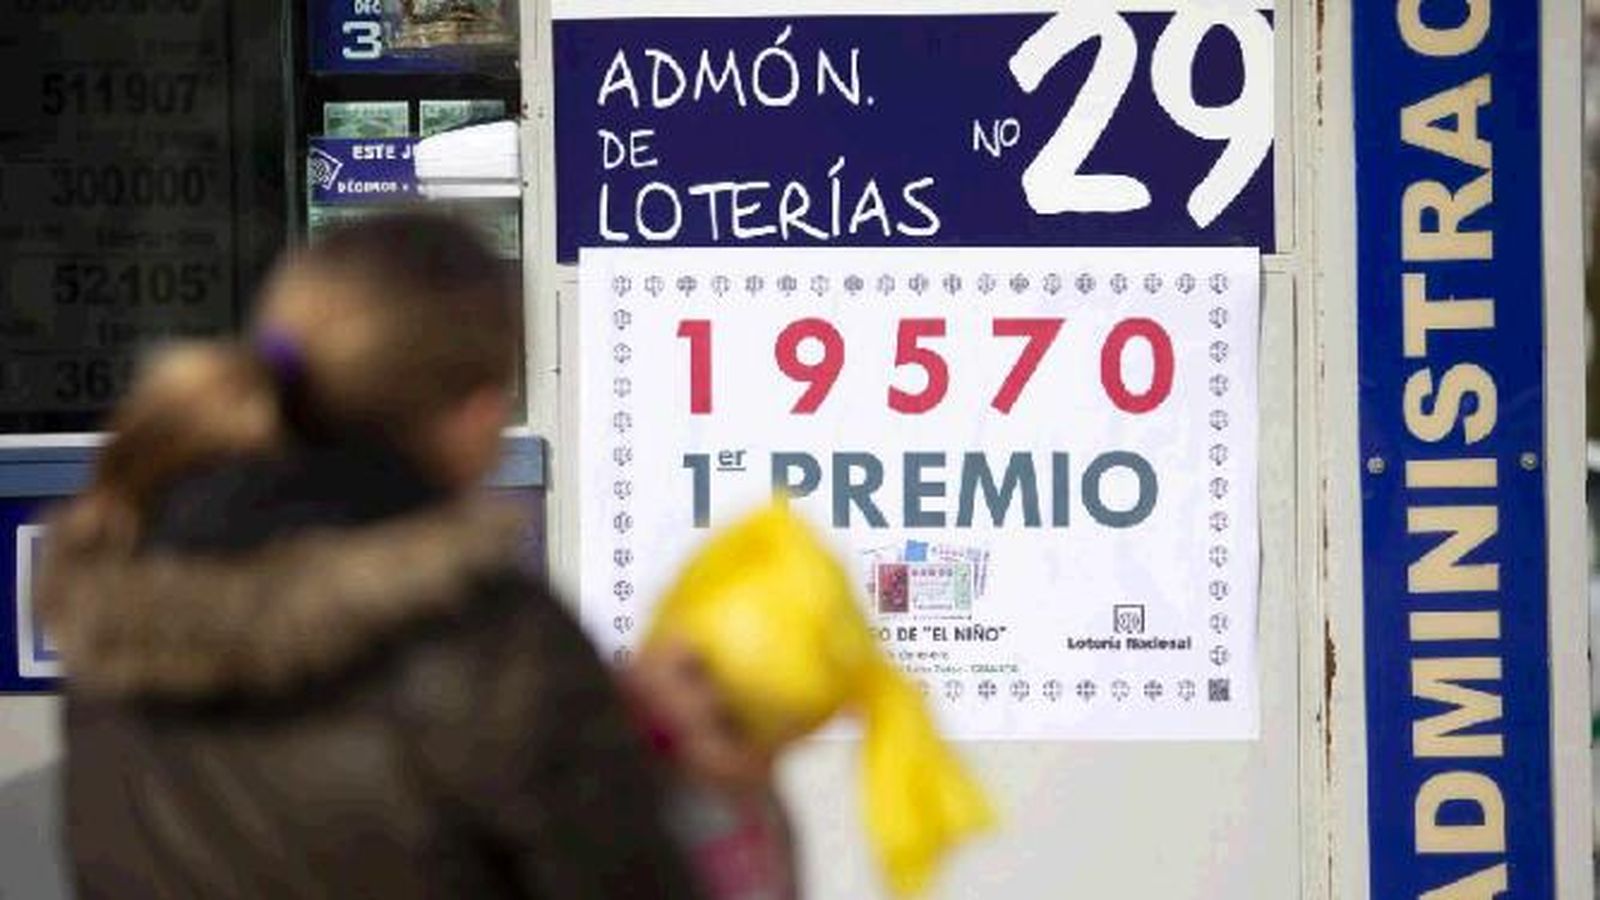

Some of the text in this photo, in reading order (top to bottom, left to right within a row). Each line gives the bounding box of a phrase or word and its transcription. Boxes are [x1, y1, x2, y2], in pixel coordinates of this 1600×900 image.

[596, 25, 875, 108] ADMÓN.
[352, 144, 397, 160] ESTE
[600, 130, 658, 169] DE
[1009, 2, 1274, 229] 29
[598, 156, 941, 242] LOTERÍAS
[677, 317, 1174, 415] 19570
[771, 451, 1158, 528] PREMIO
[897, 627, 918, 642] DE
